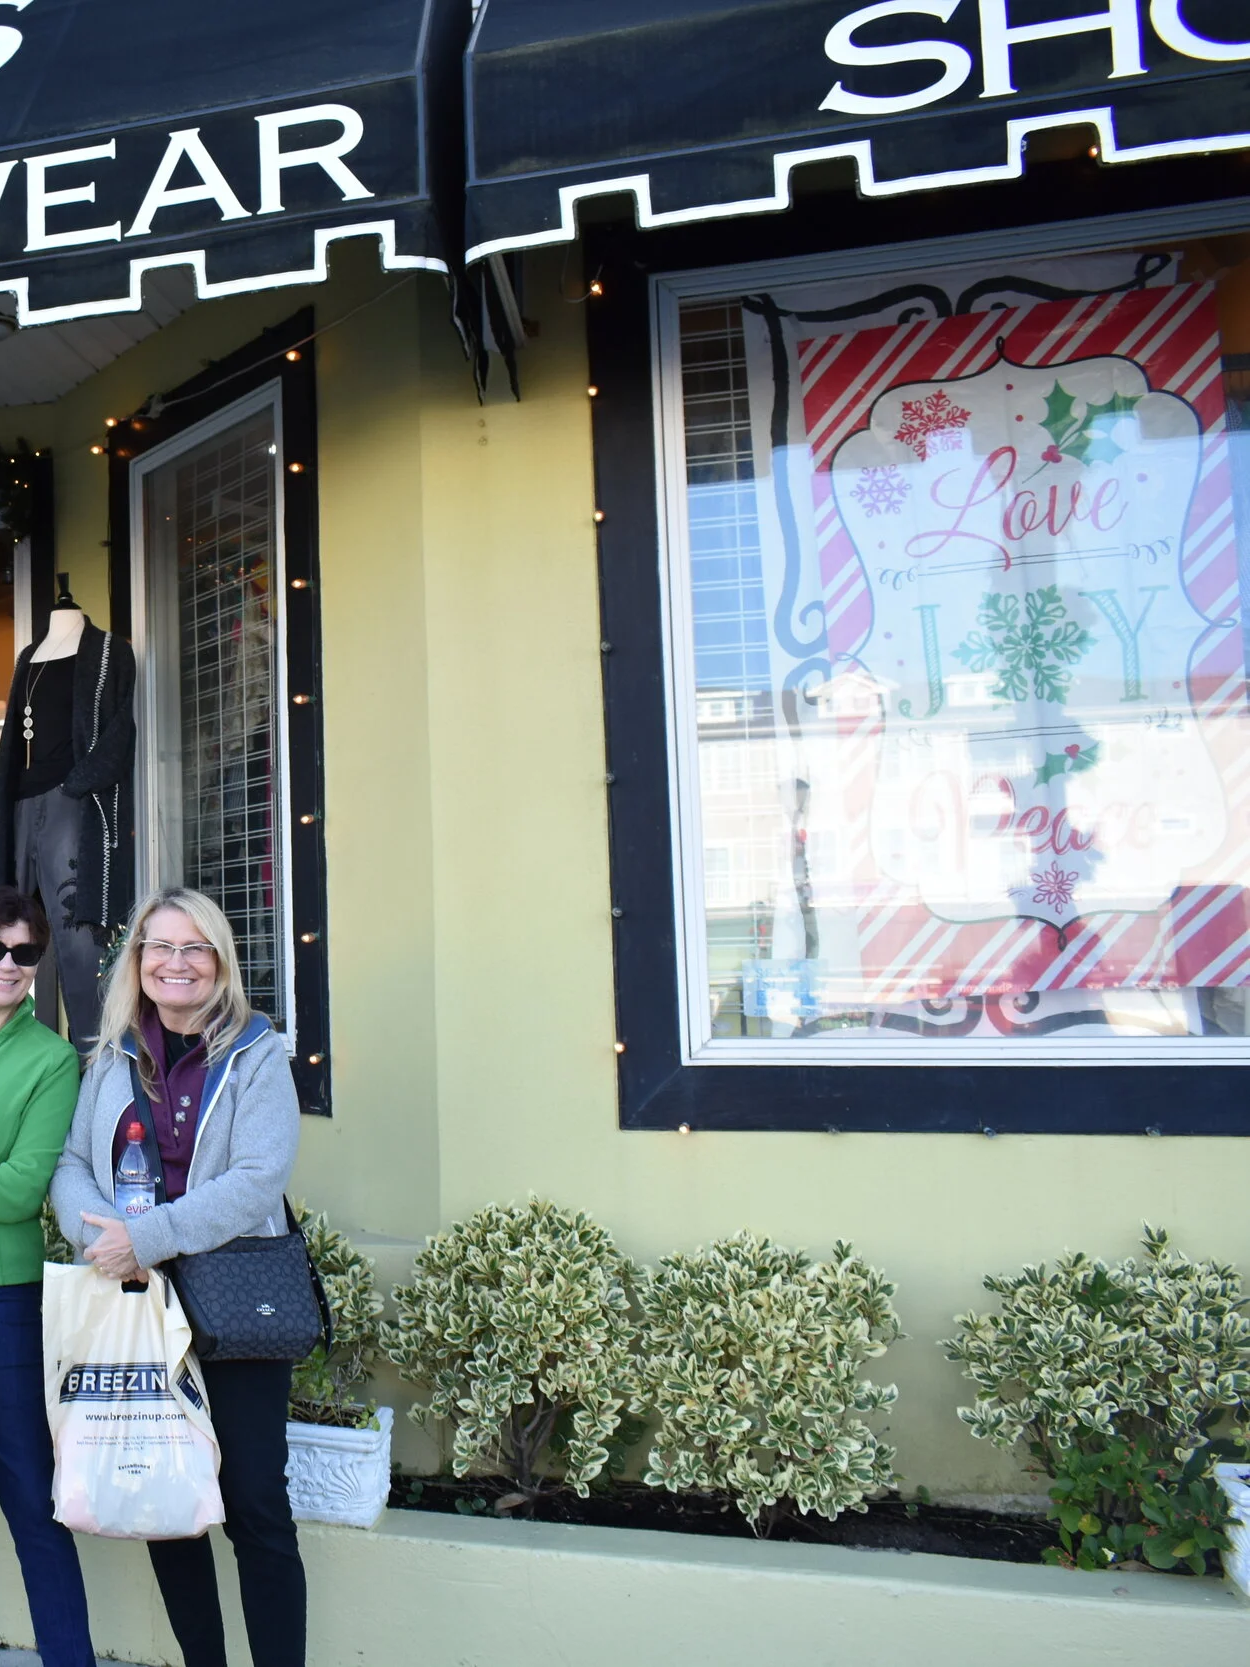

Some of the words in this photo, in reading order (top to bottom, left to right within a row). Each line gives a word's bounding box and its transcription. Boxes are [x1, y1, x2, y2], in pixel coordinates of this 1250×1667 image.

[905, 446, 1129, 571] Love
[68, 1371, 167, 1392] BREEZIN
[85, 1412, 187, 1423] www.breezinup.com
